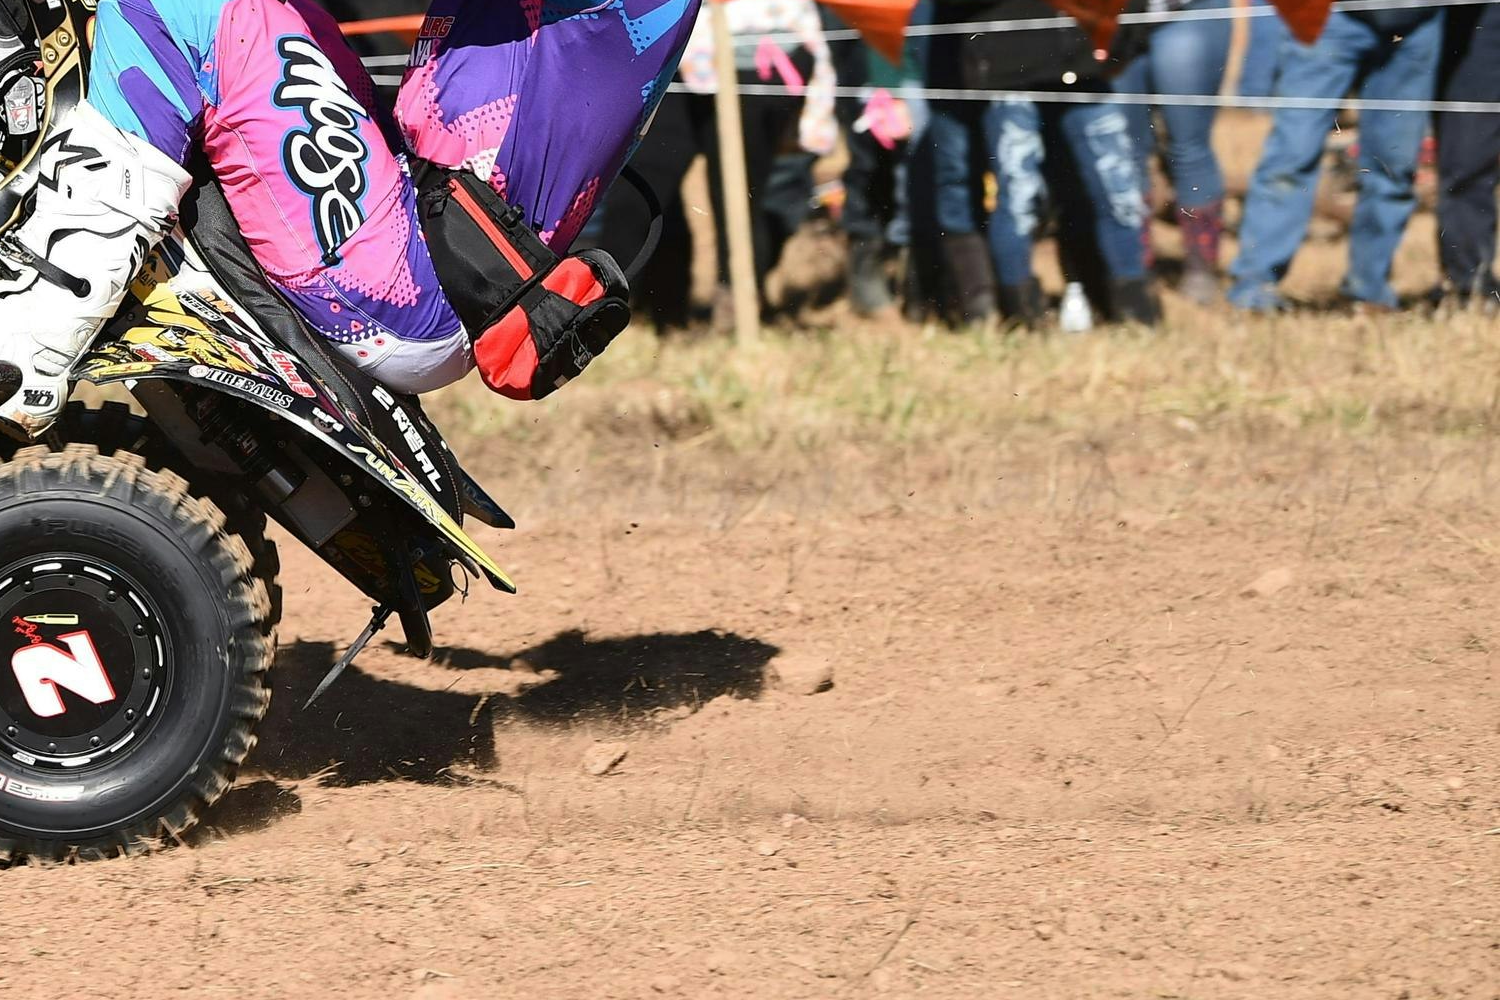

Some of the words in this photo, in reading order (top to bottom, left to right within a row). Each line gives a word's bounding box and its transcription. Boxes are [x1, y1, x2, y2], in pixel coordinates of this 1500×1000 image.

[205, 368, 294, 409] TIREBALLS
[372, 385, 395, 411] 2
[392, 410, 442, 492] NEAL
[11, 630, 116, 717] 2
